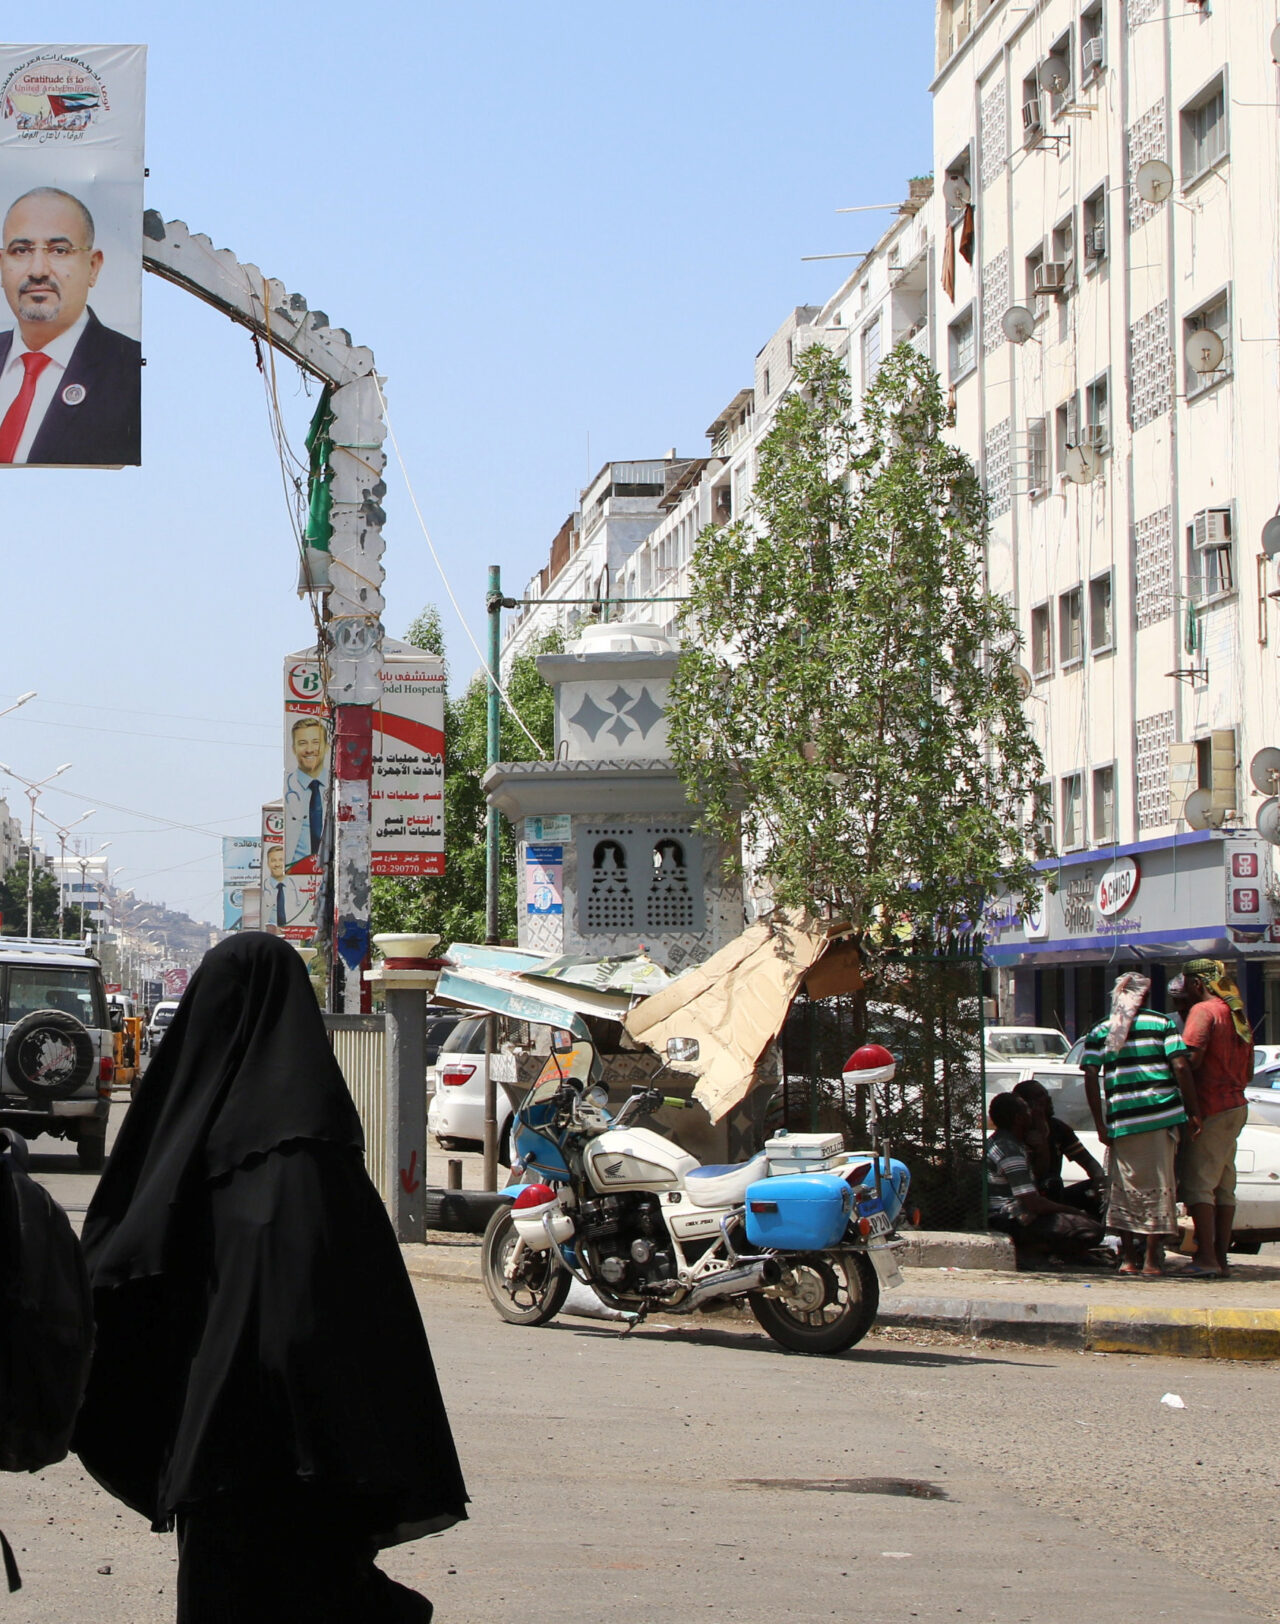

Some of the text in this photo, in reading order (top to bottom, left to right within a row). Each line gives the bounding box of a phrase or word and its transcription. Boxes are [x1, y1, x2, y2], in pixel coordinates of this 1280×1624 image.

[23, 74, 85, 84] Gratitude is to
[14, 84, 40, 92] United
[394, 670, 445, 682] مستشفى
[383, 684, 402, 694] odel
[386, 753, 419, 764] عمليات
[387, 790, 420, 802] عمليات
[1108, 870, 1131, 905] CHIGO
[1064, 905, 1091, 927] CHIGO
[821, 1142, 844, 1157] POLICE
